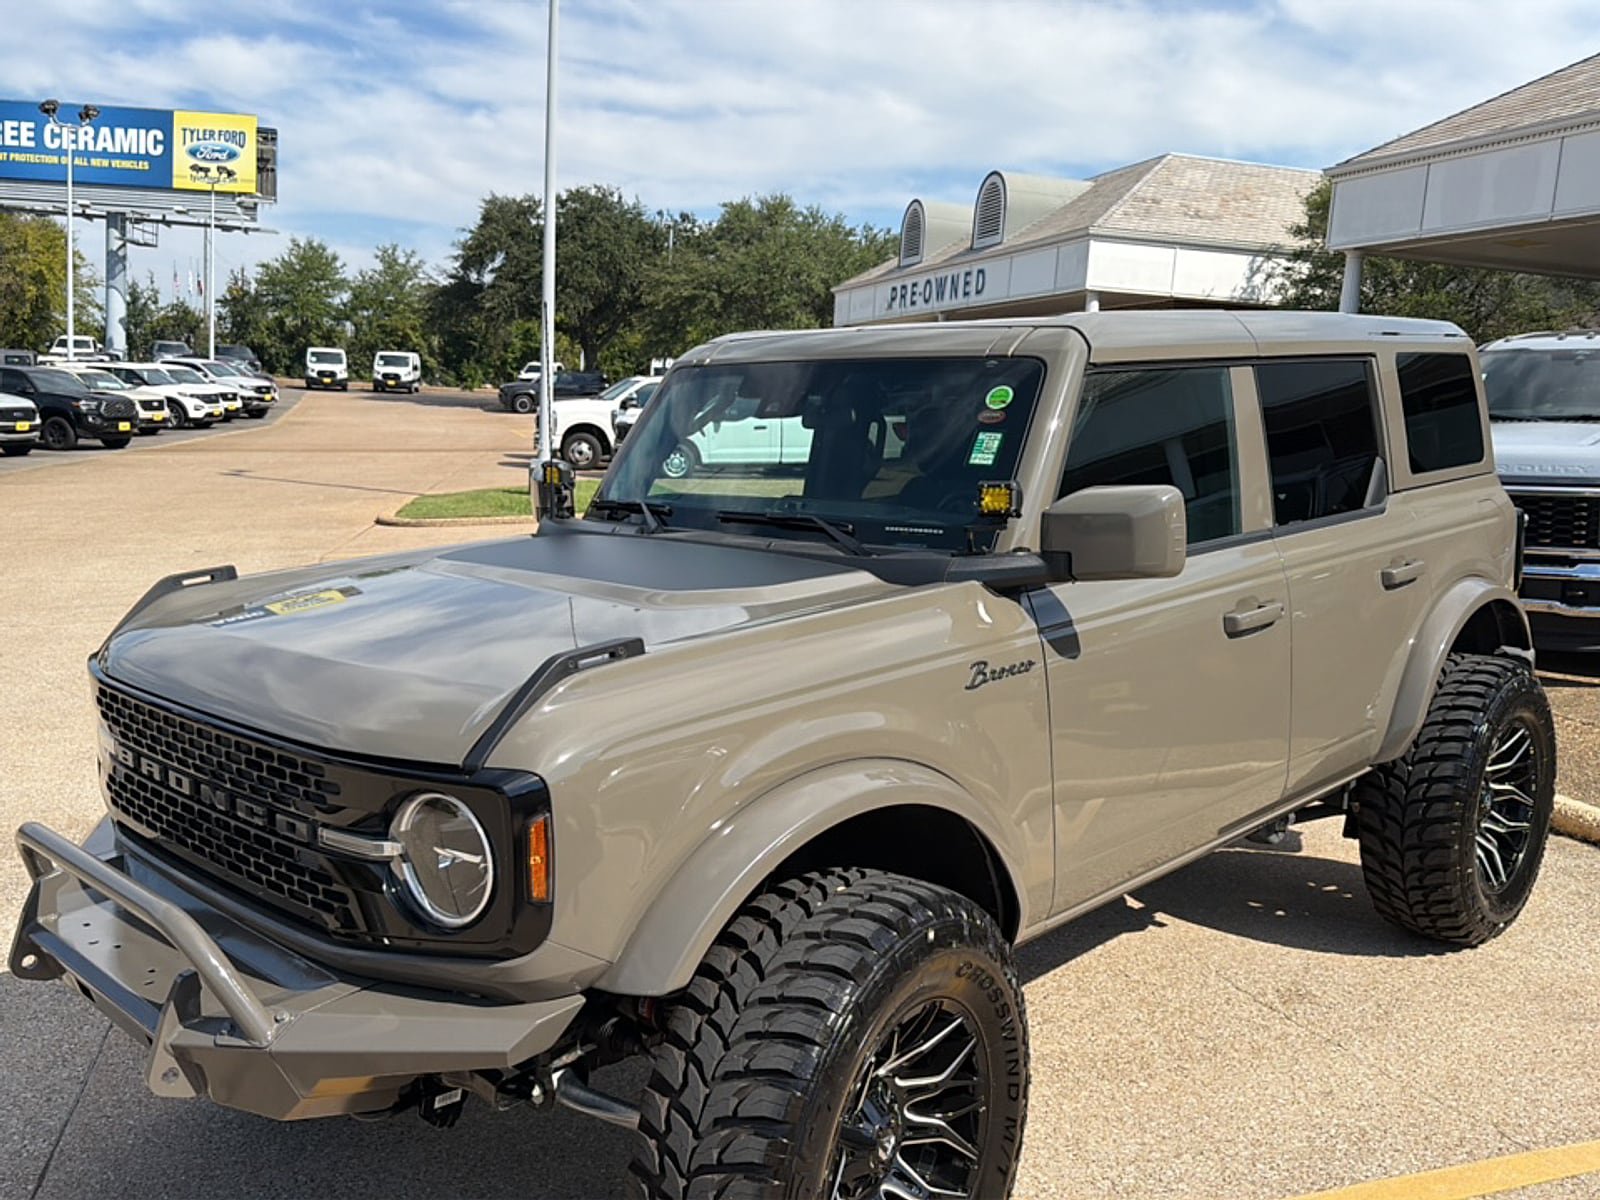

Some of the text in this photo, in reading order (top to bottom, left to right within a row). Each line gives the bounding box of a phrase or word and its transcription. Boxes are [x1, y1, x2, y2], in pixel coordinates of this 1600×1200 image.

[0, 119, 165, 156] EE CERAMIC
[181, 127, 247, 149] TYLER FORD
[196, 144, 229, 160] Ford
[887, 268, 986, 310] PRE-OWNED
[964, 660, 1036, 690] Bronco
[114, 744, 310, 842] BRONCO
[956, 960, 1020, 1102] CROSSWIND
